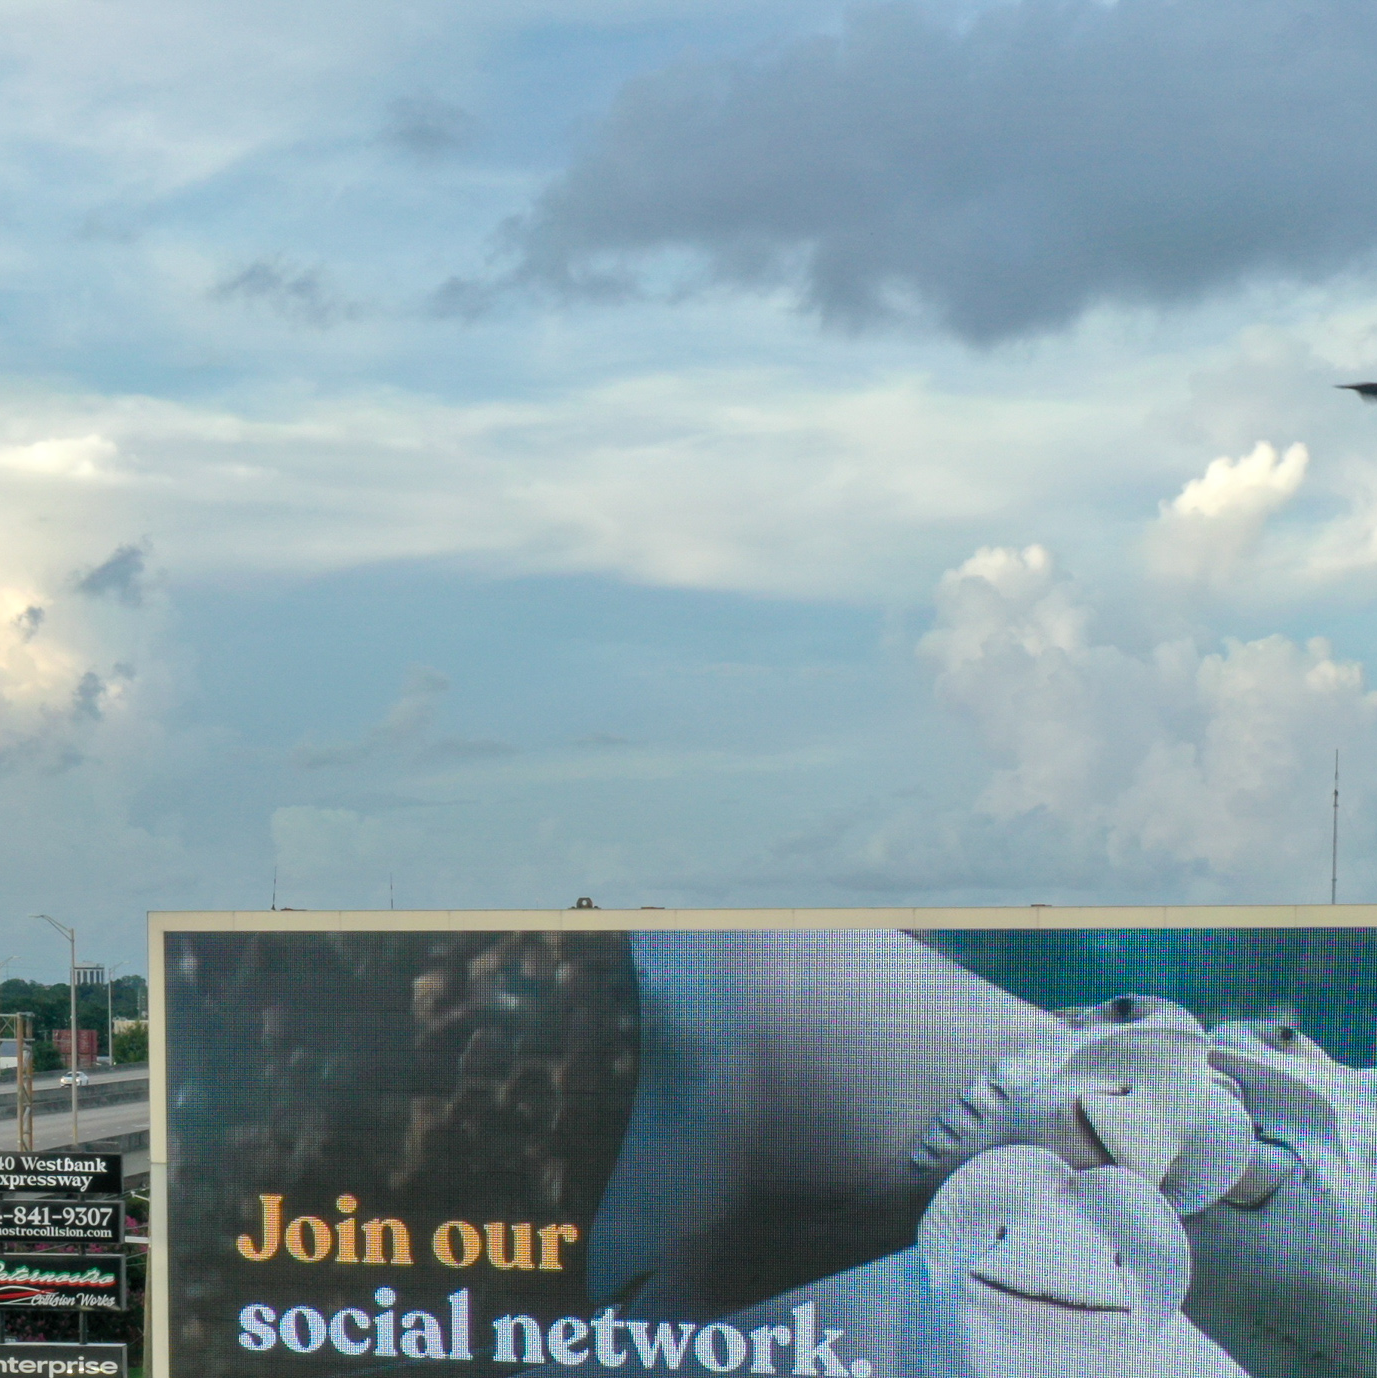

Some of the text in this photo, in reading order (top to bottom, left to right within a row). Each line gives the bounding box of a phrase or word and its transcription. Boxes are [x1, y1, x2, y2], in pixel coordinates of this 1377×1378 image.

[20, 1156, 108, 1173] Westbank
[236, 1194, 577, 1271] Join our
[31, 1293, 116, 1307] Collision Works
[238, 1286, 872, 1378] social network.
